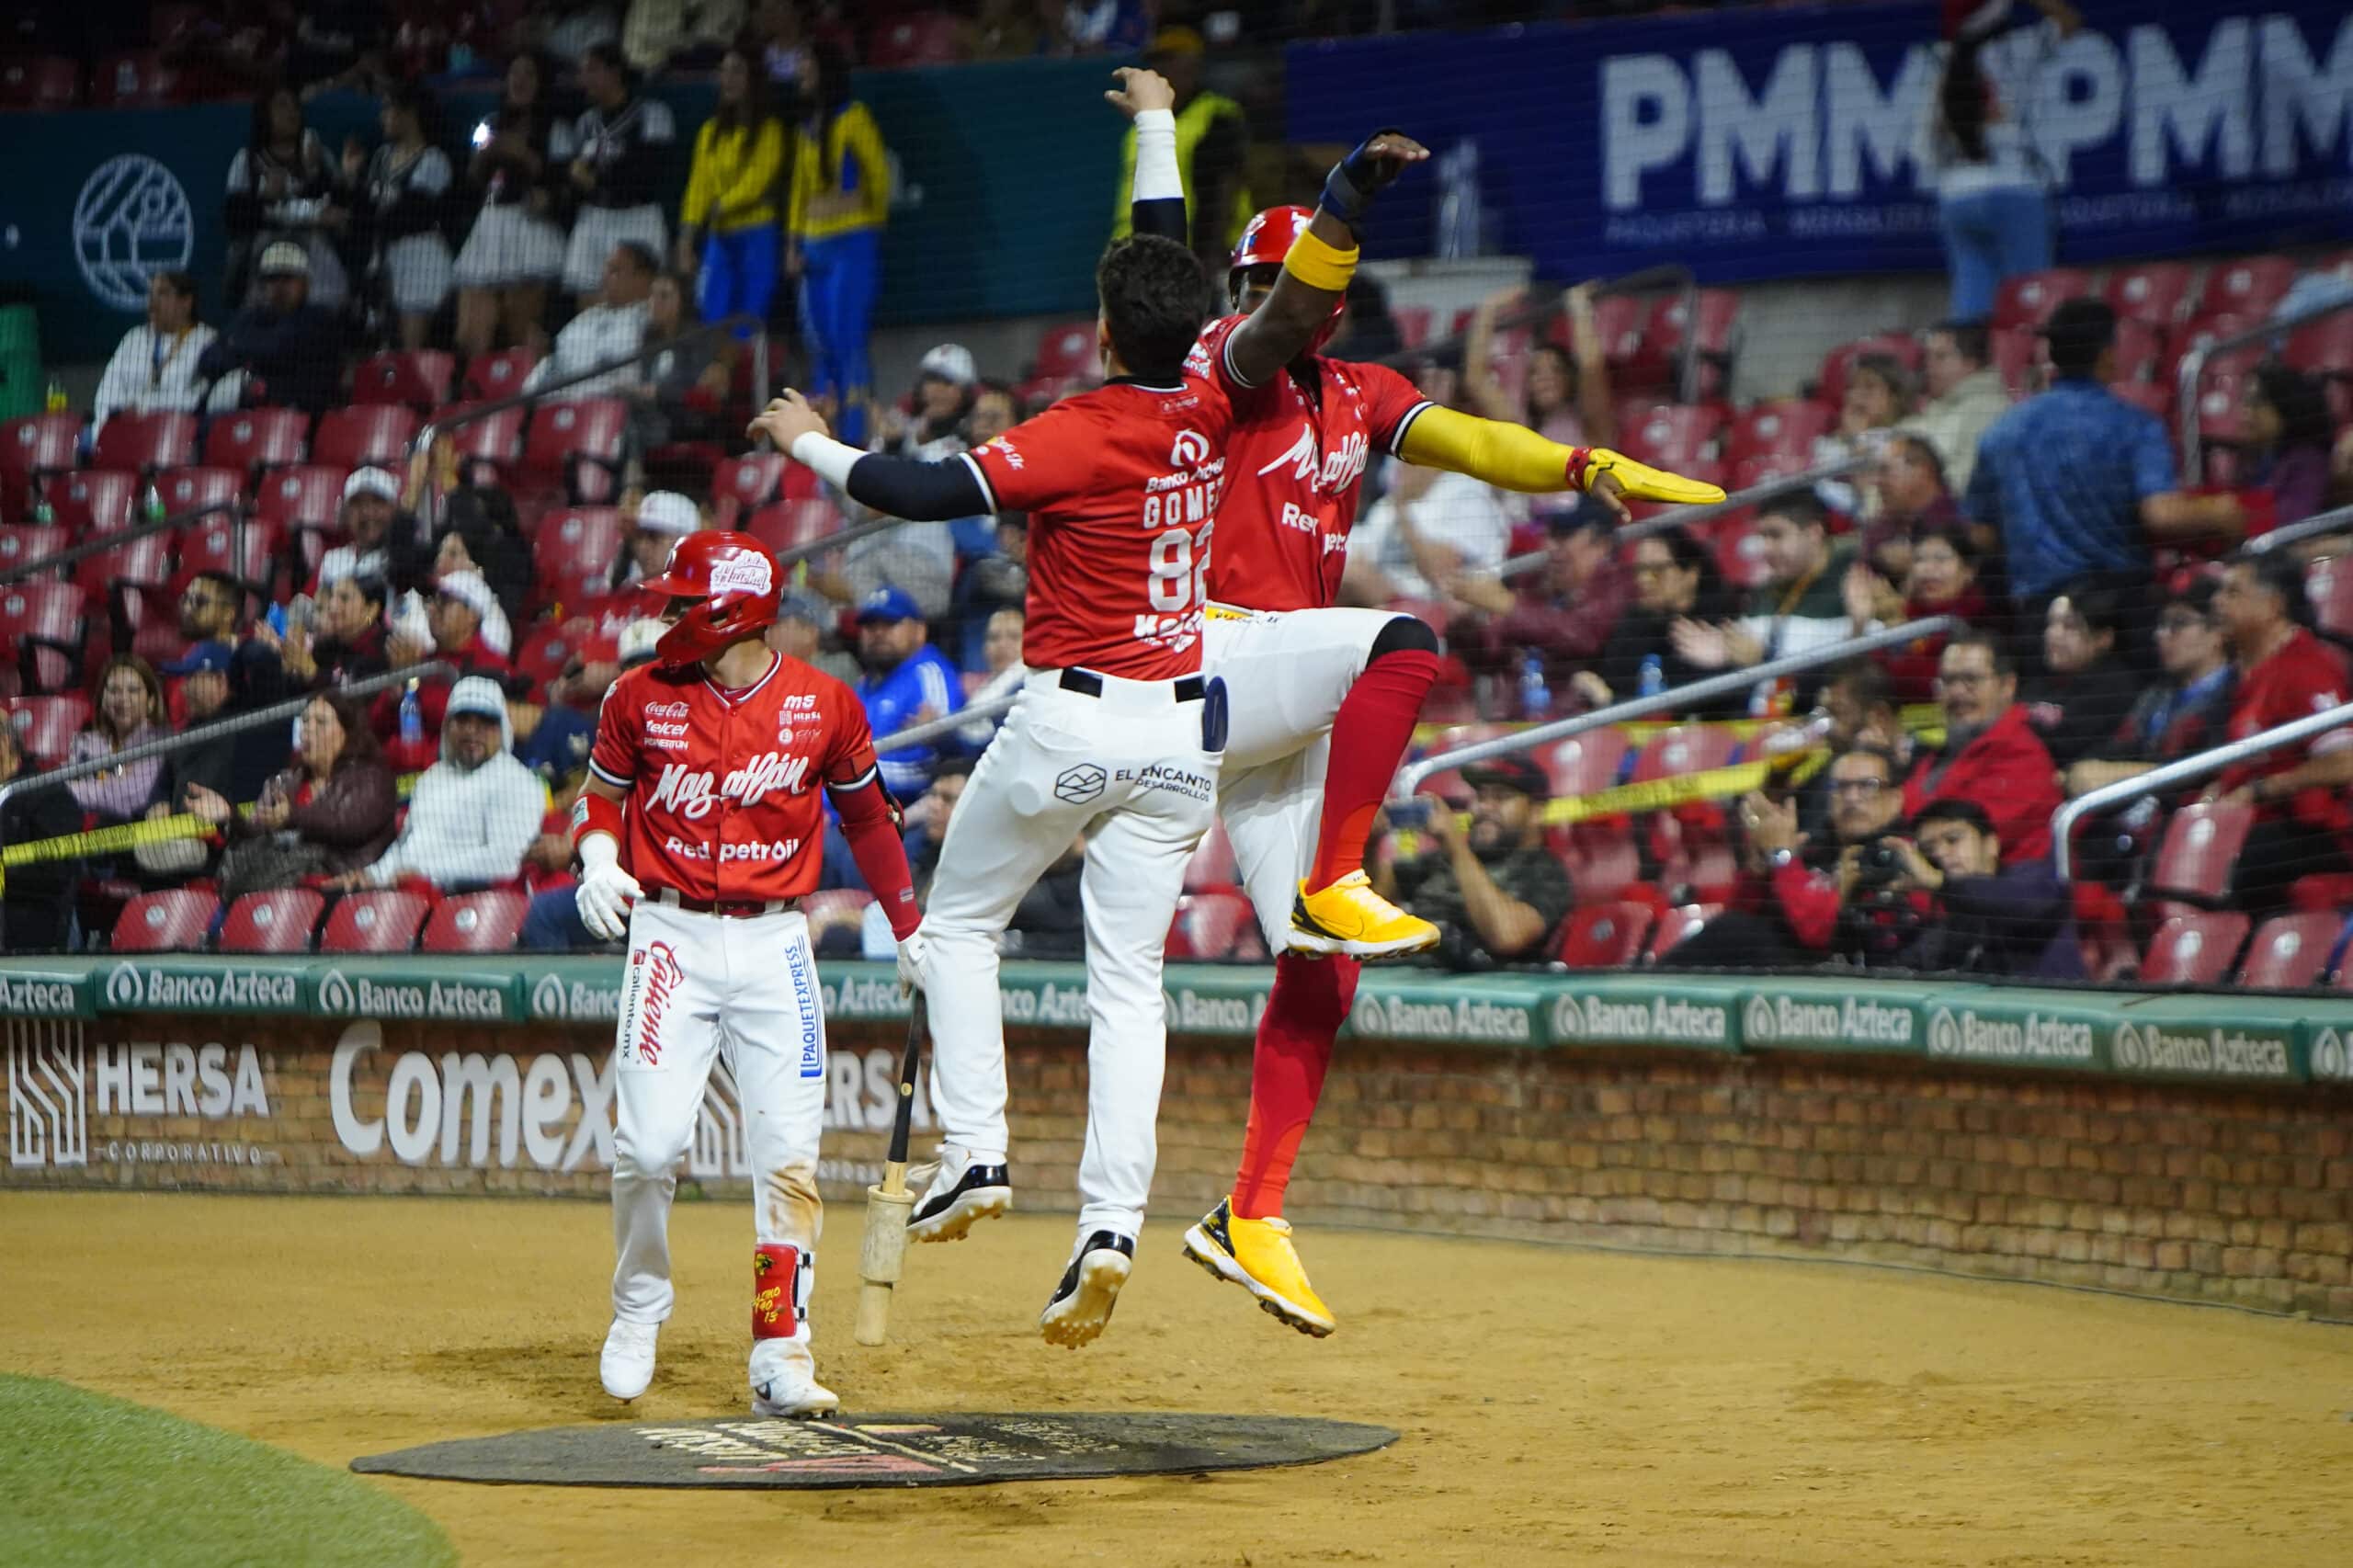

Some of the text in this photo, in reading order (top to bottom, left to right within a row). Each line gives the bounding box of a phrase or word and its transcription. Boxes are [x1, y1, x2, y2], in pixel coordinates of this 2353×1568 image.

[646, 721, 689, 736] telcel
[1115, 765, 1211, 790] EL ENCANTO
[1136, 778, 1210, 801] DESARROLLOS
[665, 836, 711, 859] Red
[148, 968, 296, 1007] Banco Azteca
[358, 978, 503, 1017] Banco Azteca
[639, 939, 685, 1066] Caliente
[784, 944, 816, 1062] PAQUETEXPRESS
[622, 966, 642, 1059] caliente.mx
[1182, 991, 1247, 1031] Banco
[1387, 997, 1529, 1037] Banco Azteca
[1586, 995, 1725, 1039] Banco Azteca
[1779, 996, 1912, 1042] Banco Azteca
[1963, 1011, 2093, 1057] Banco Azteca
[2145, 1026, 2289, 1074] Banco Azteca
[97, 1042, 270, 1119] HERSA
[329, 1019, 619, 1176] Comex
[108, 1141, 262, 1165] CORPORATIVO
